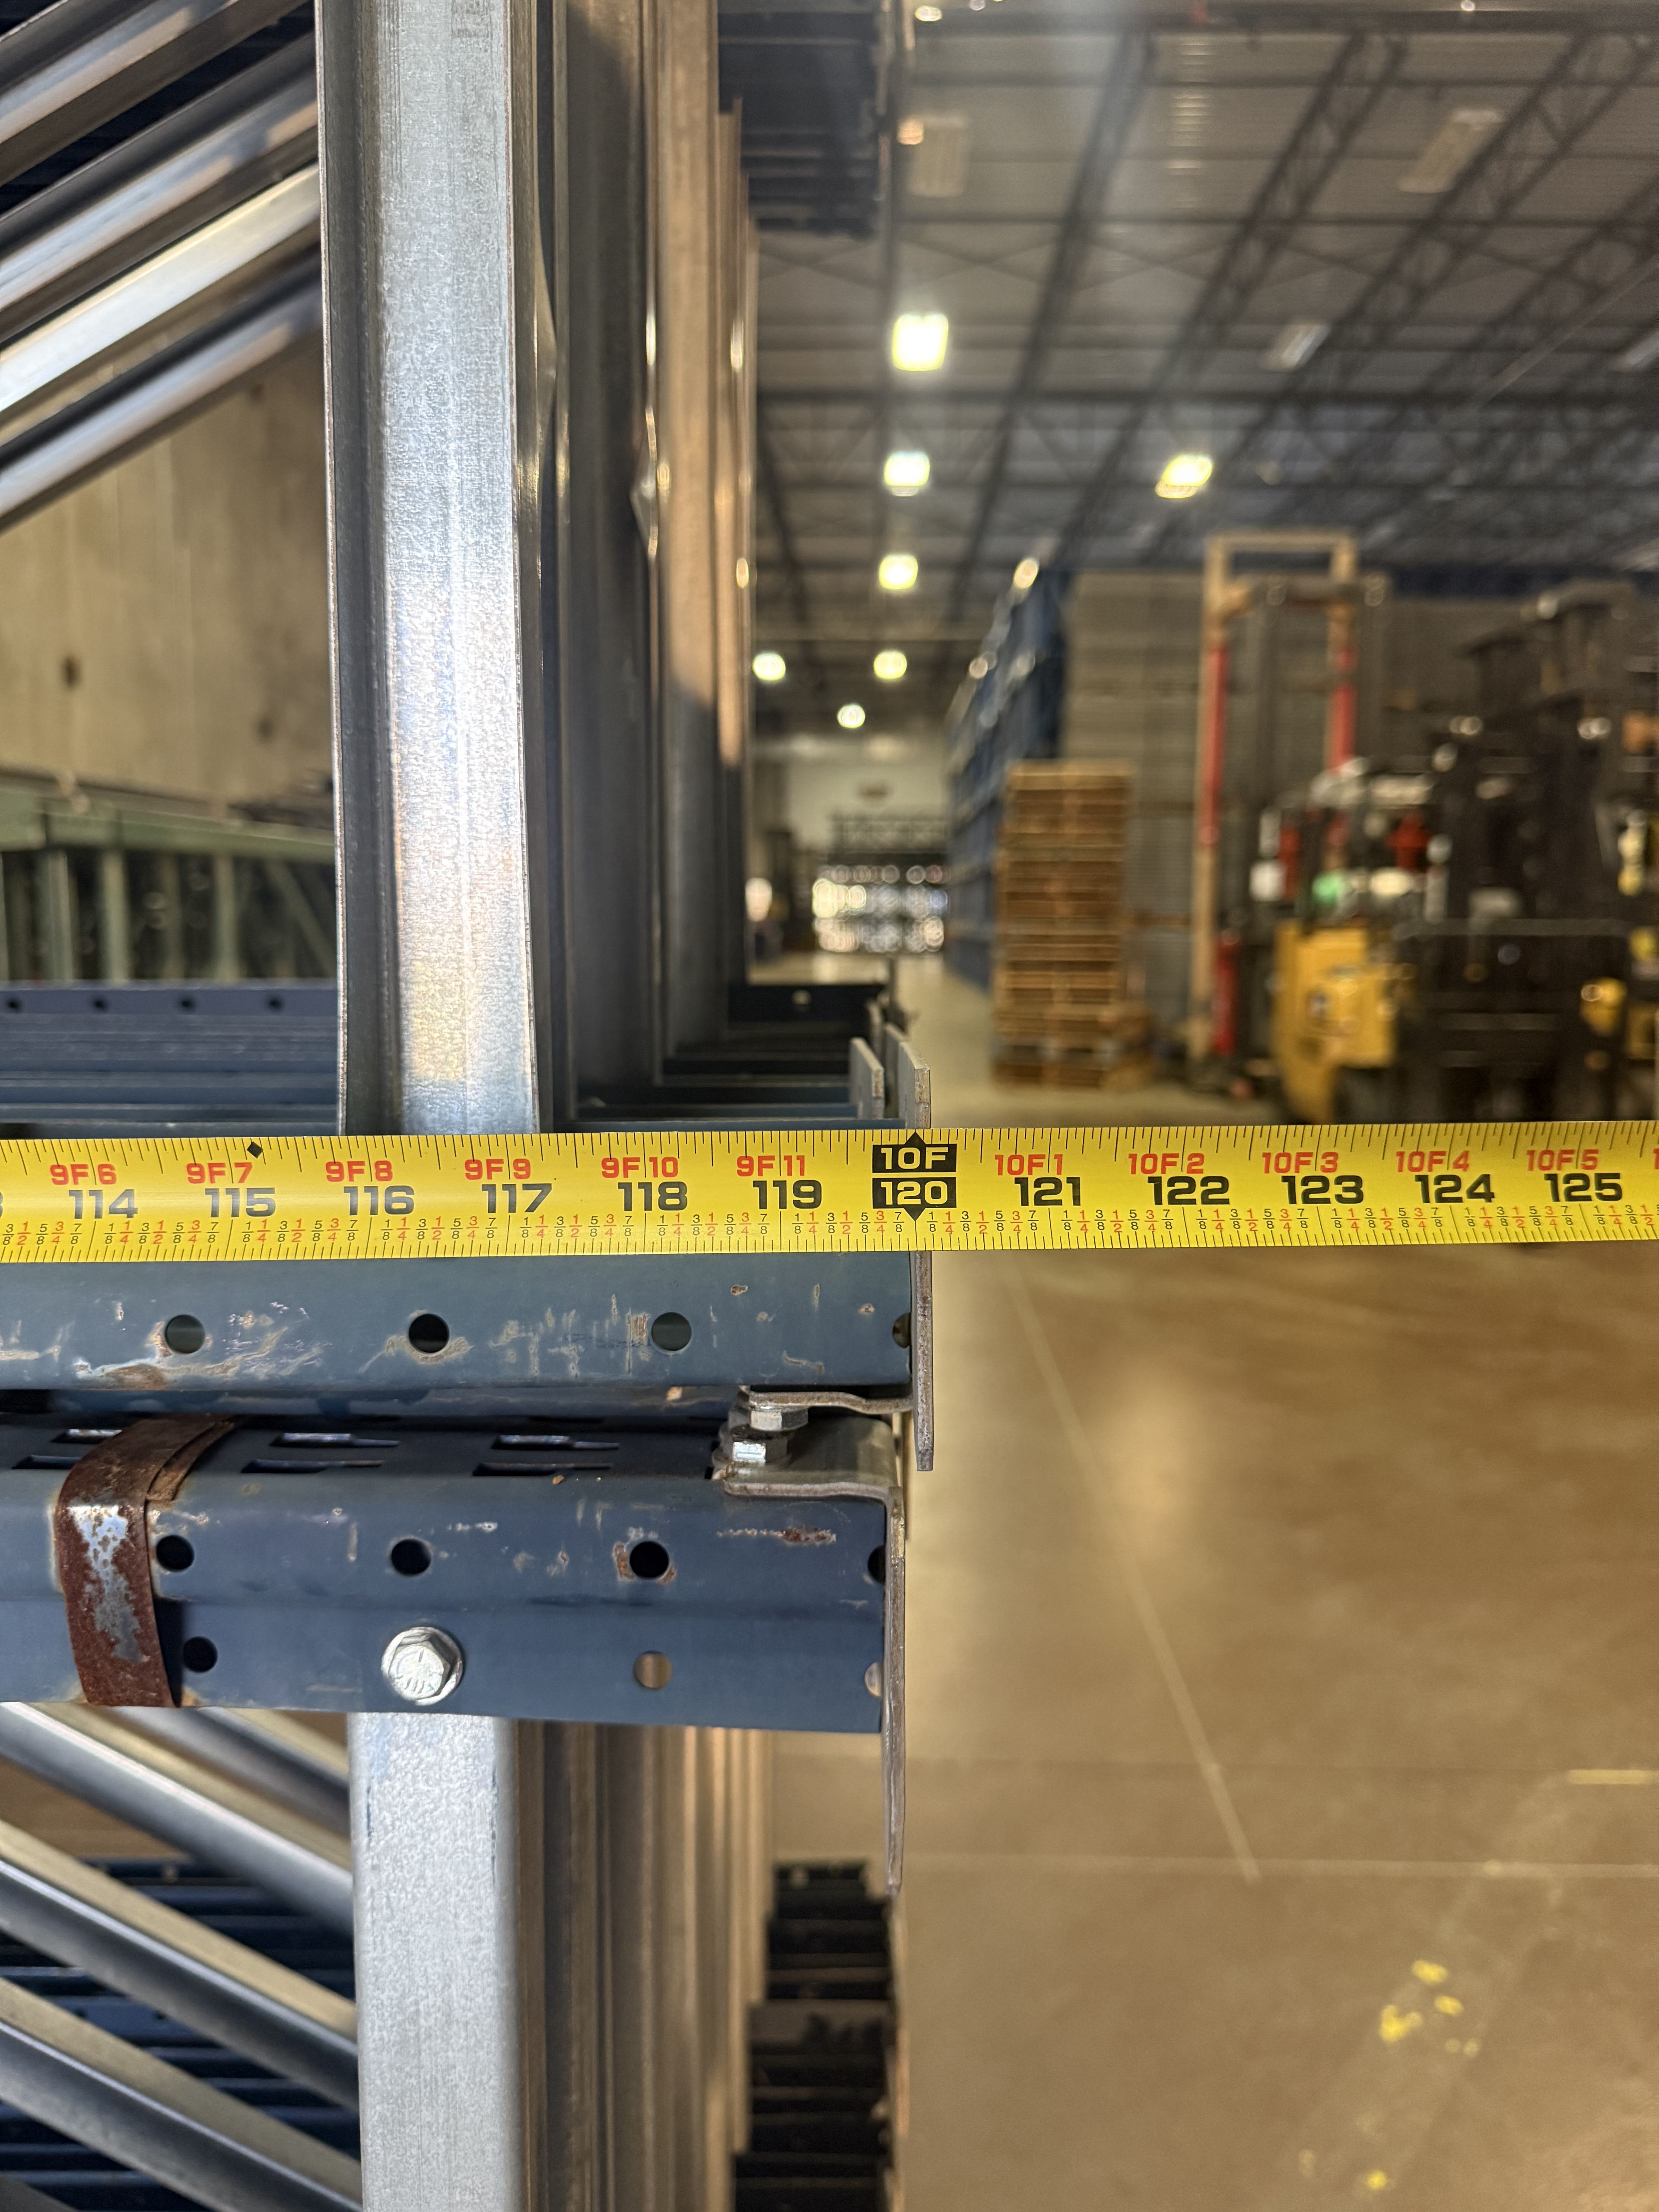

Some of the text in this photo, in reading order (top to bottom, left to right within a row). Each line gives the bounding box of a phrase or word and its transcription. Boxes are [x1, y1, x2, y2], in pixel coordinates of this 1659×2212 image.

[881, 1147, 949, 1170] 10F
[69, 1173, 1623, 1219] 114 115 116 117 118 119 120 121 122 123 124 125
